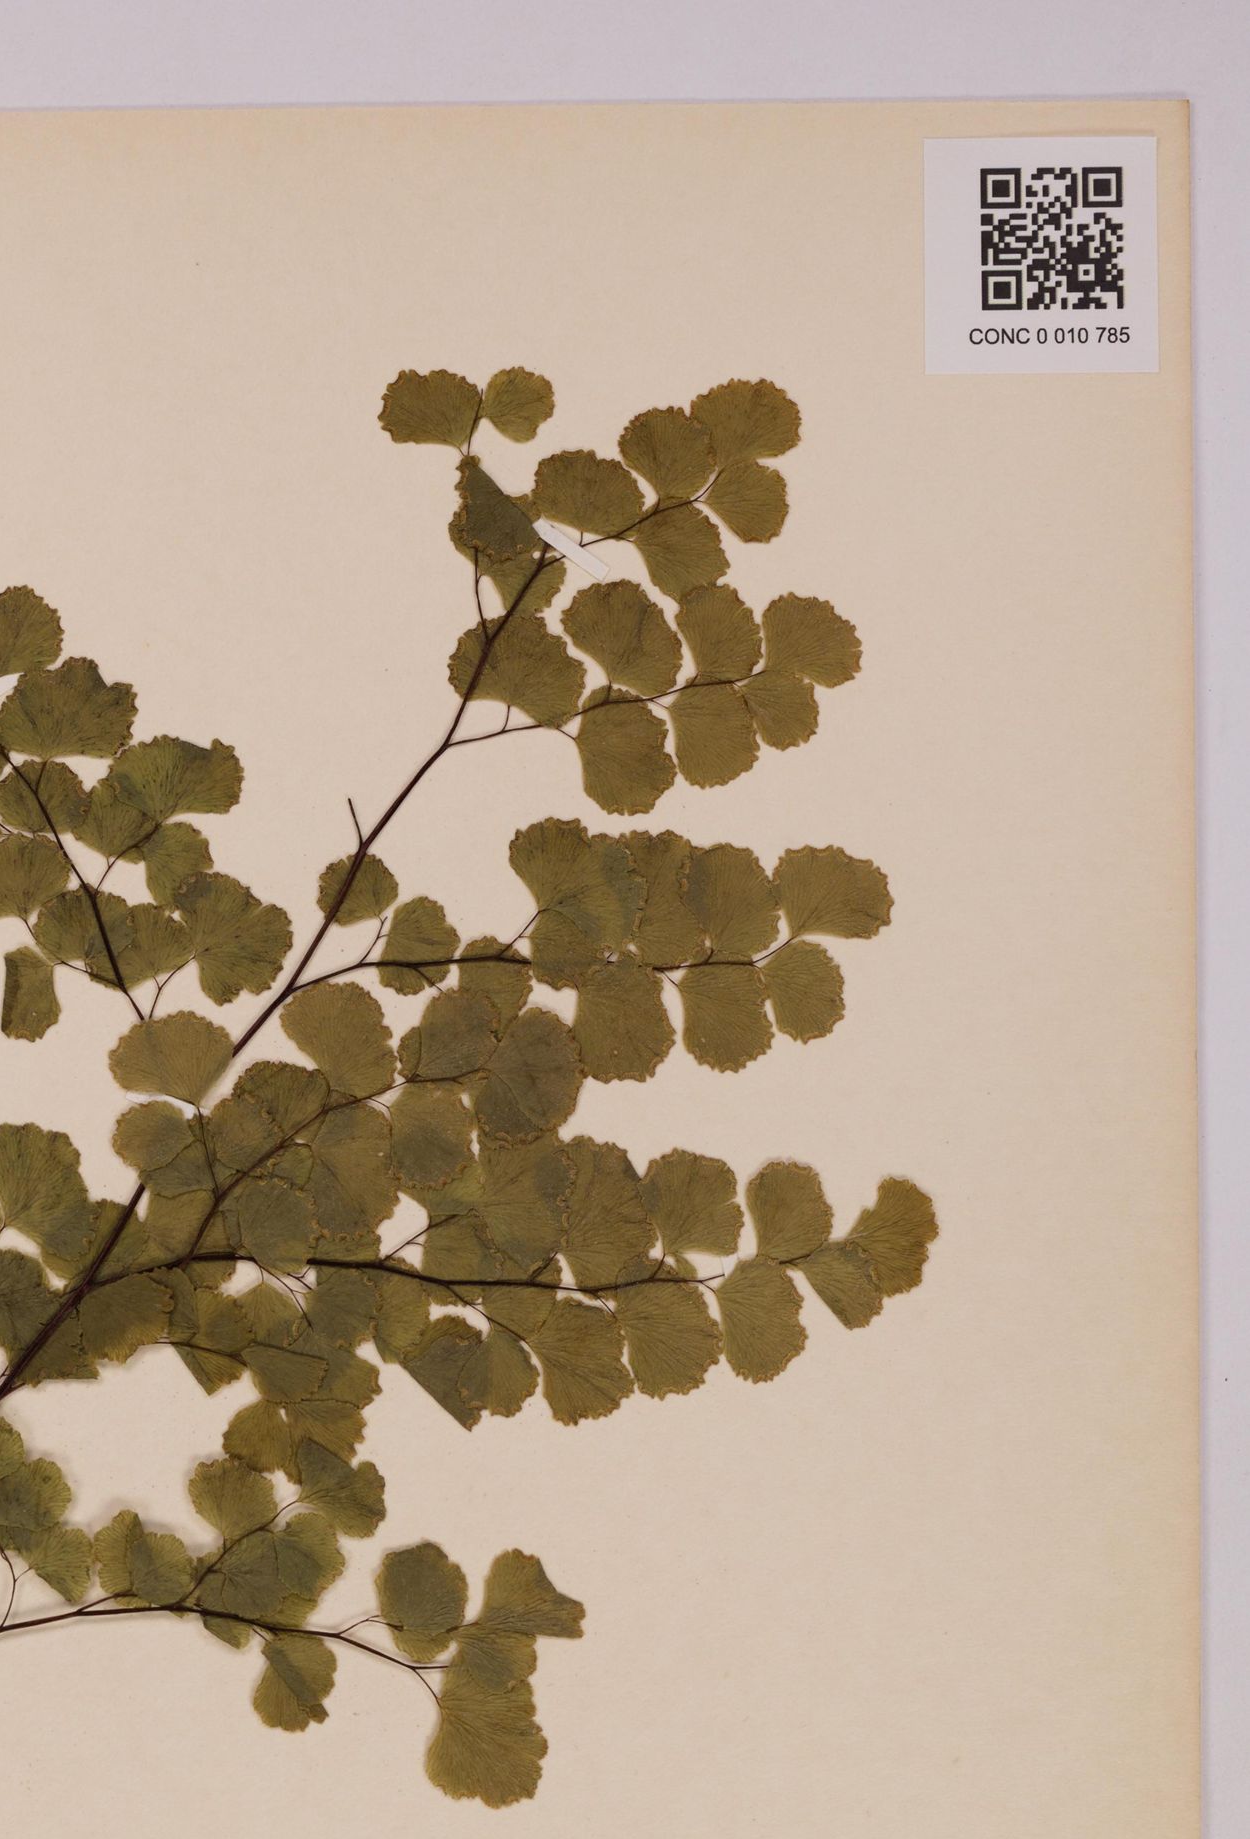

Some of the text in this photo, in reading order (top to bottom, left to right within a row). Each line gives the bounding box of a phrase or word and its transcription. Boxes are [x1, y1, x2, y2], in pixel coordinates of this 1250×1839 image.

[969, 326, 1131, 345] CONC 0 010 785
